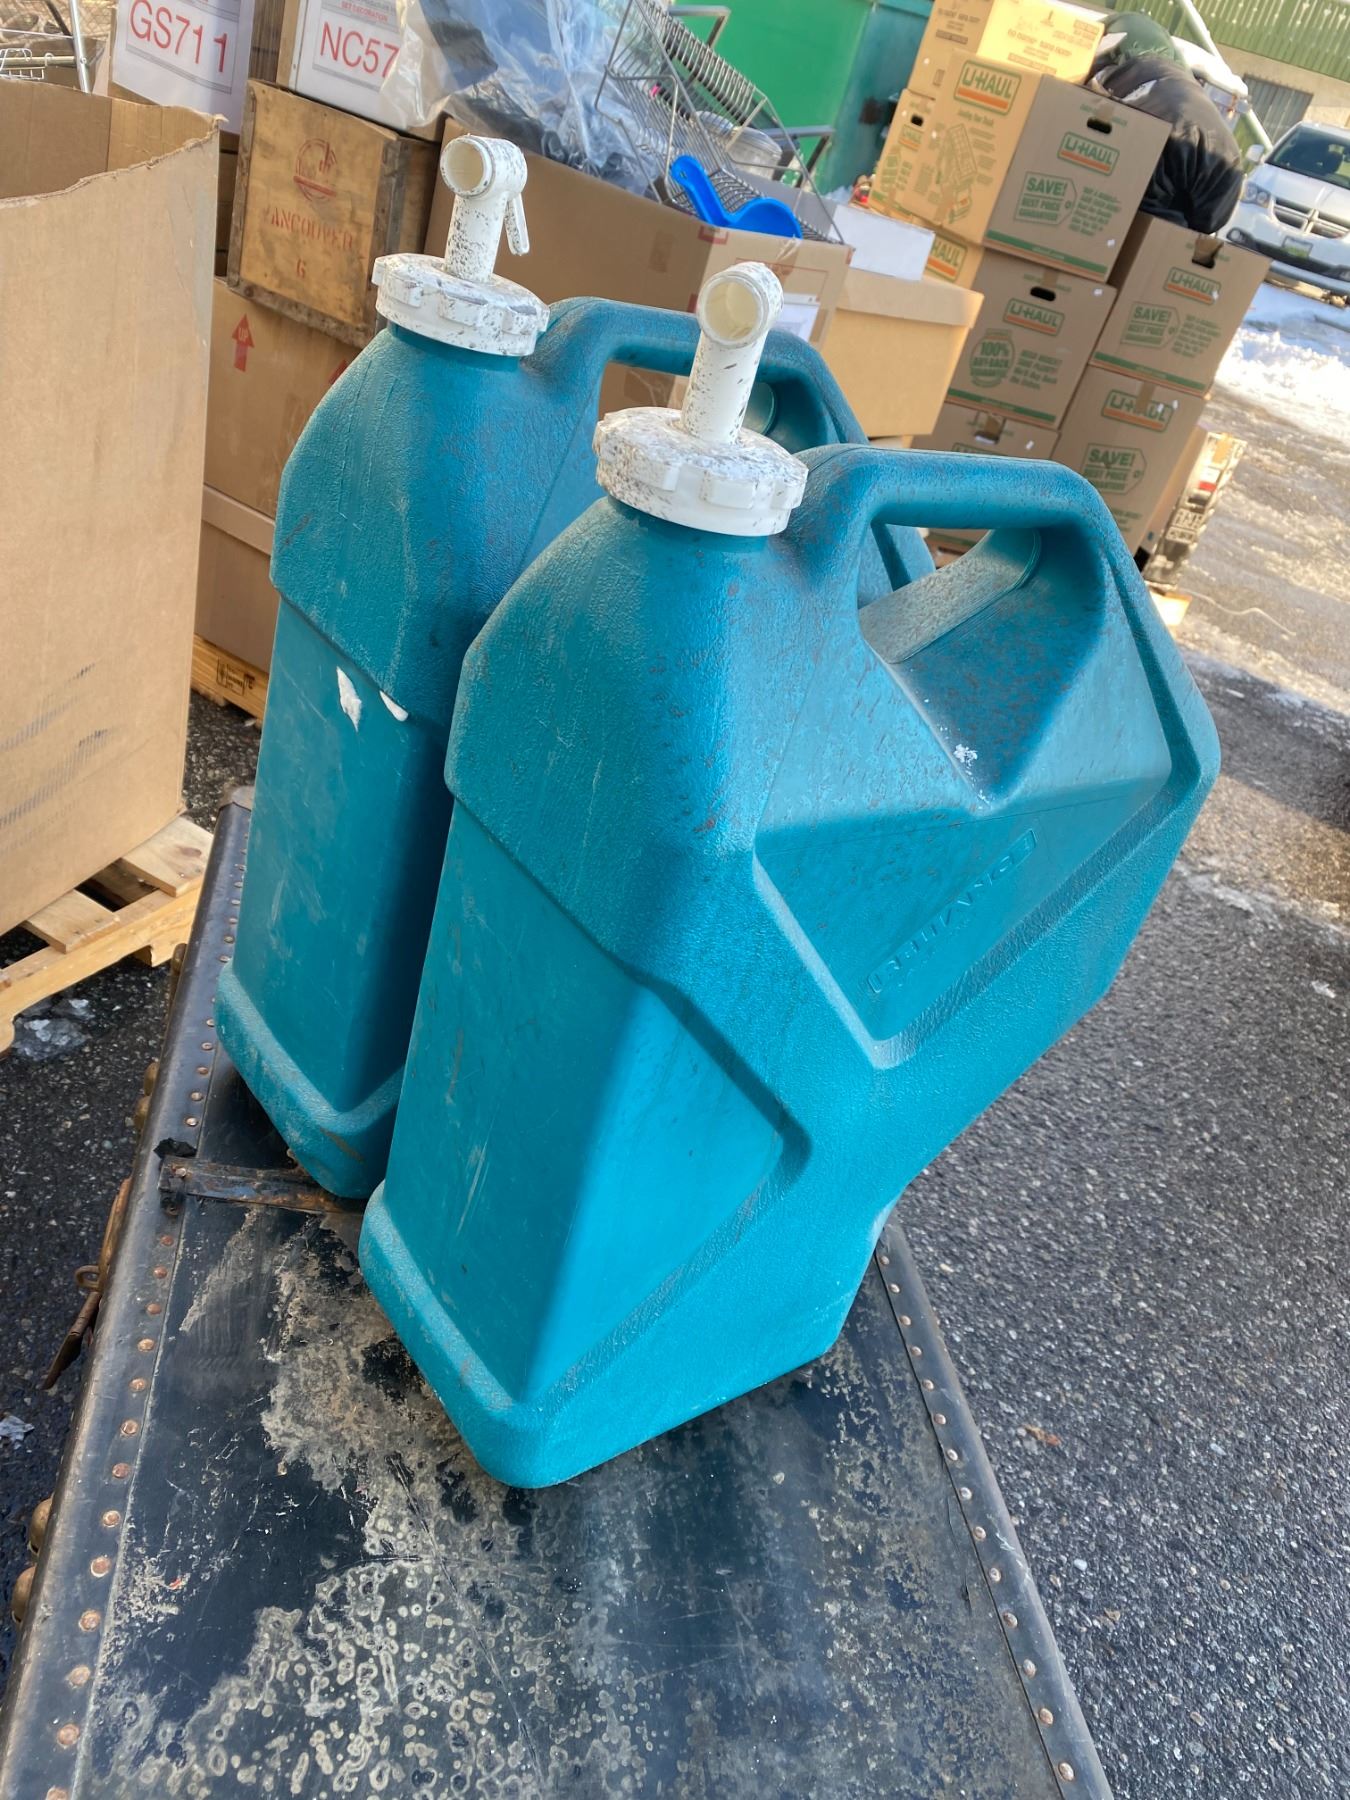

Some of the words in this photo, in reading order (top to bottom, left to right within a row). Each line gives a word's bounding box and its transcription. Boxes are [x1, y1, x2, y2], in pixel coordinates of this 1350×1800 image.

[962, 71, 1014, 101] U-HAUL
[1064, 138, 1117, 168] U-HAUL
[1026, 177, 1068, 197] SAVE!
[1009, 303, 1061, 331] U-HAUL
[1088, 448, 1136, 468] SAVE!
